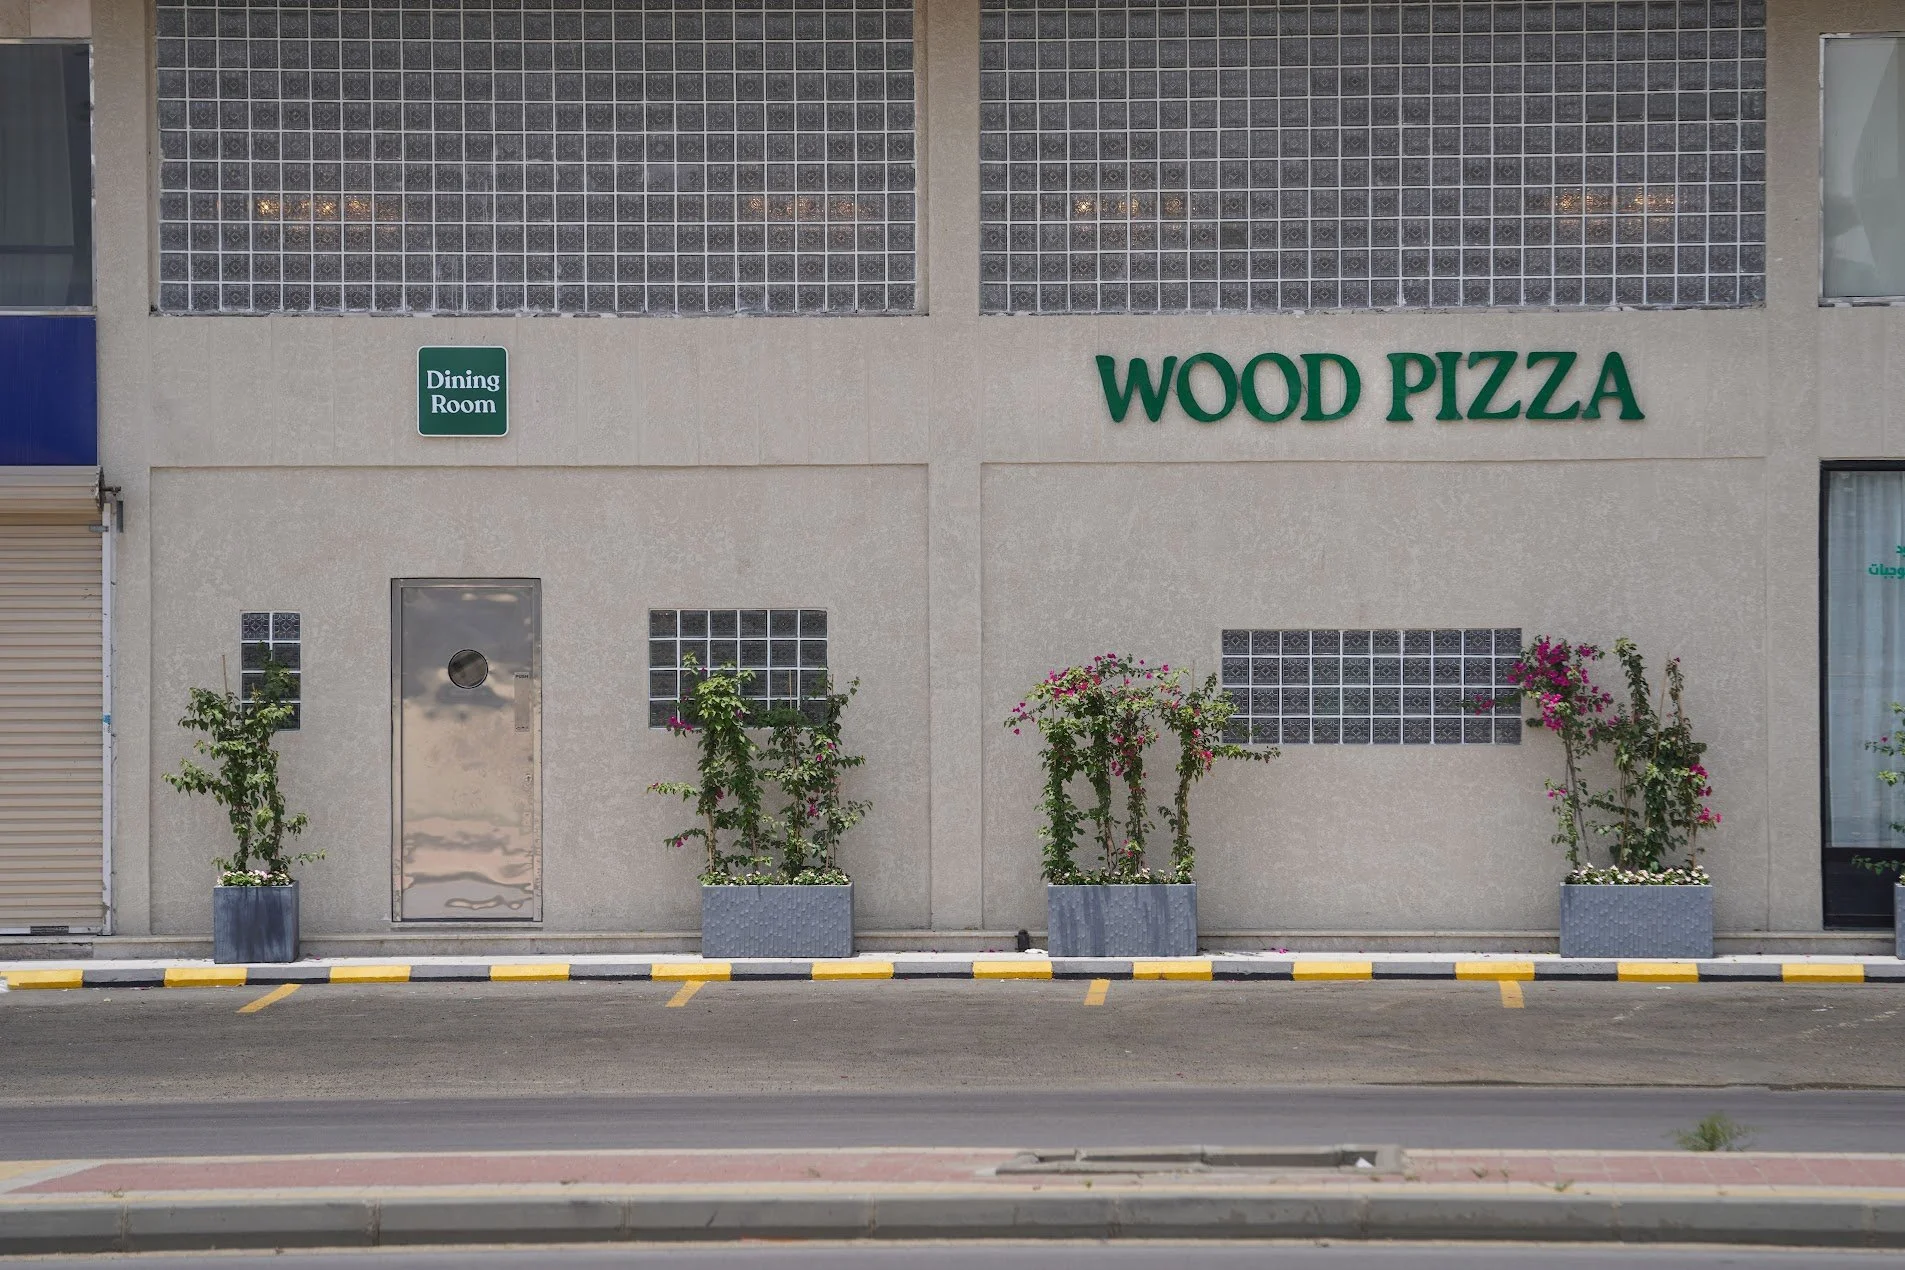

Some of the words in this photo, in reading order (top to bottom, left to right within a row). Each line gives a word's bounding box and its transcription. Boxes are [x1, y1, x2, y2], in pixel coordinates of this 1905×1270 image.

[427, 370, 500, 392] Dining
[1096, 352, 1361, 422] WOOD
[1386, 351, 1645, 422] PIZZA
[431, 395, 496, 413] Room
